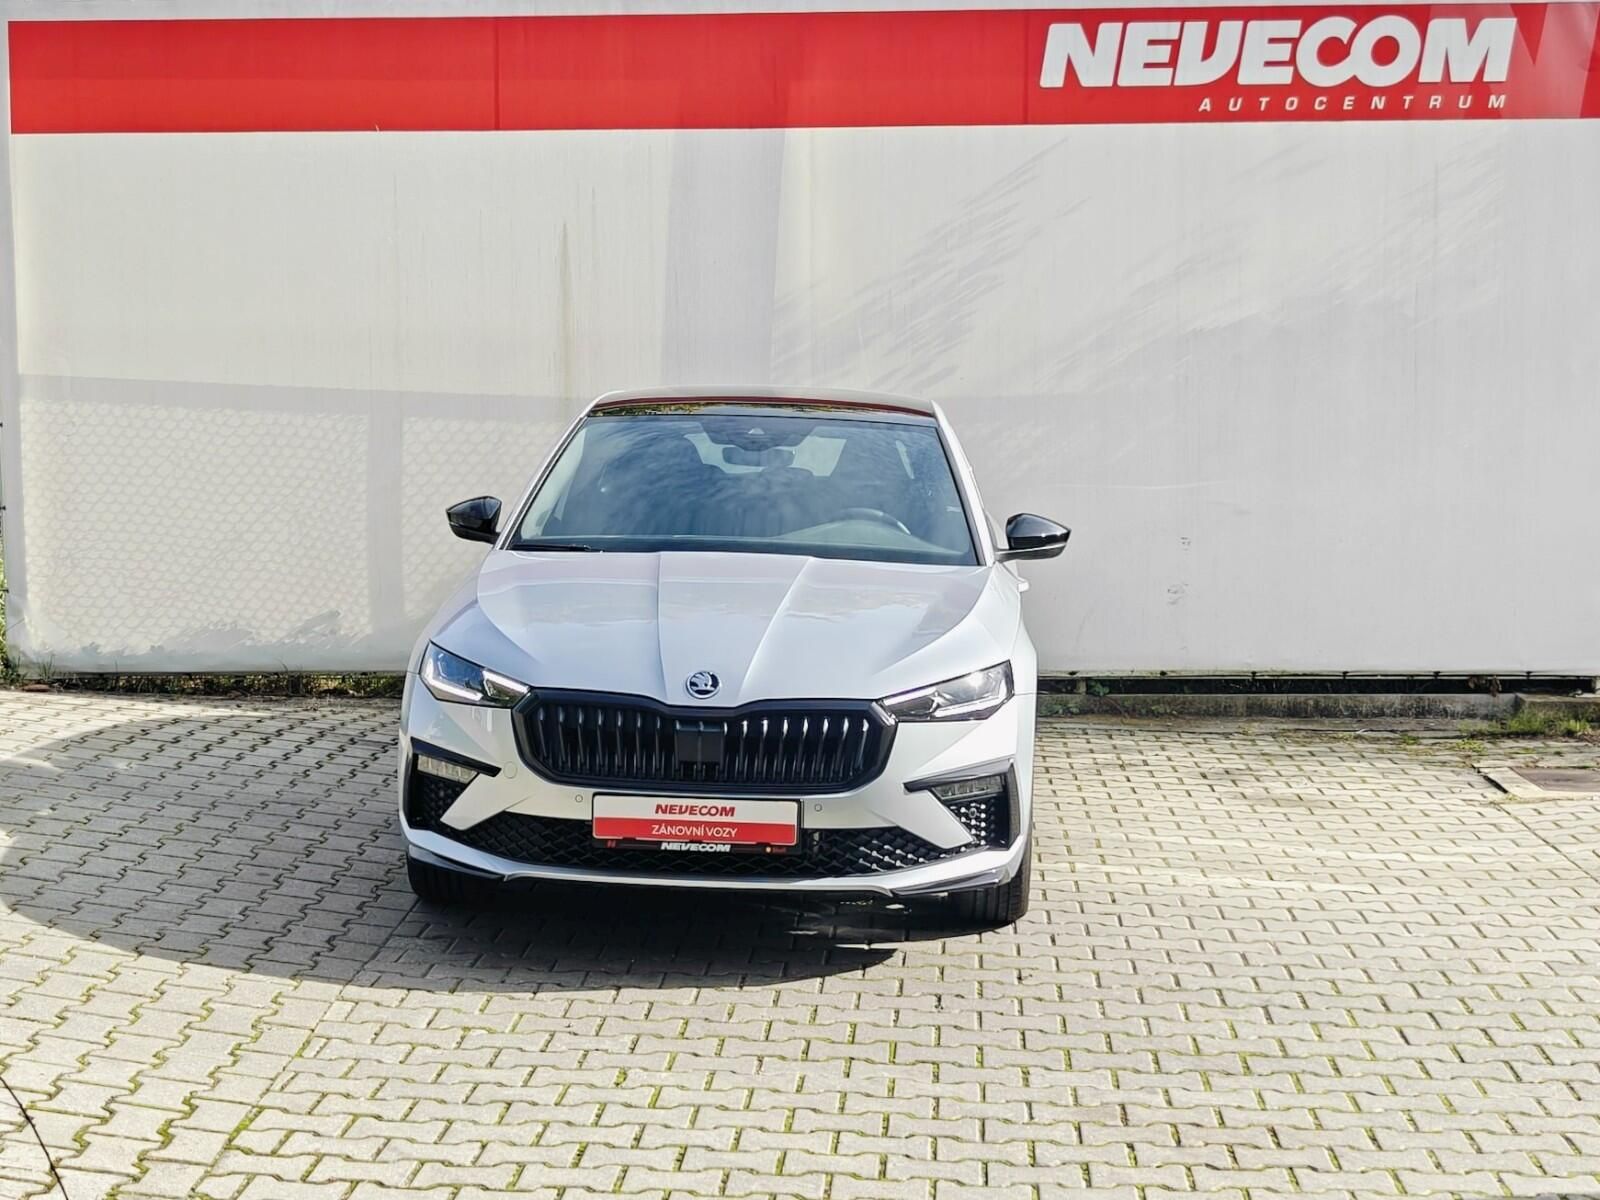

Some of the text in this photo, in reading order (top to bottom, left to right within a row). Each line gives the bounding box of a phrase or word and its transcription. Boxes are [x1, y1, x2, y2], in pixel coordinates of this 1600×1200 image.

[1040, 15, 1517, 88] NEVECOM
[1199, 95, 1507, 112] AUTOCENTRUM
[655, 803, 735, 817] NEVECOM
[651, 823, 737, 838] ZÁNOVNÍ VOZY
[660, 841, 731, 853] NEVECOM
